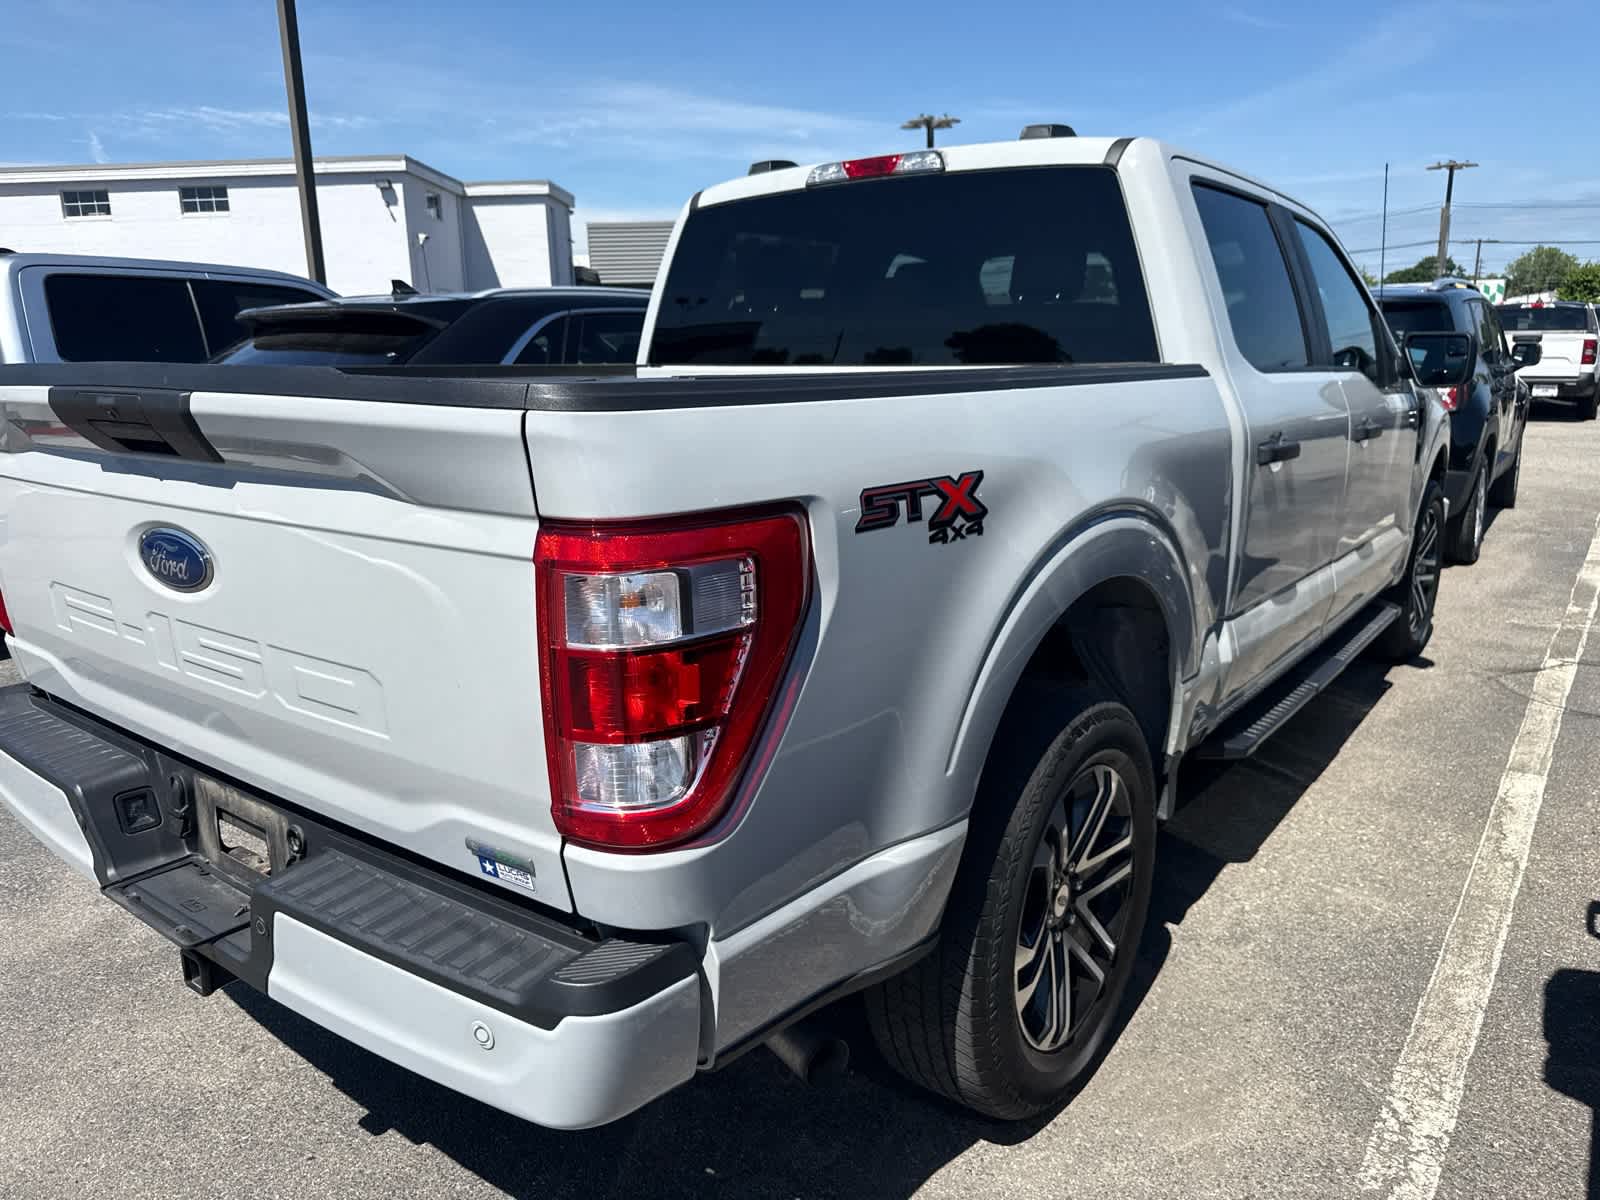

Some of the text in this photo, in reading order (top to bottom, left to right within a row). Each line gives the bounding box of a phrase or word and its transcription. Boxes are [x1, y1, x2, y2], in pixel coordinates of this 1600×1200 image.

[855, 470, 988, 534] STX
[150, 540, 189, 580] Ford
[50, 580, 391, 741] F-150
